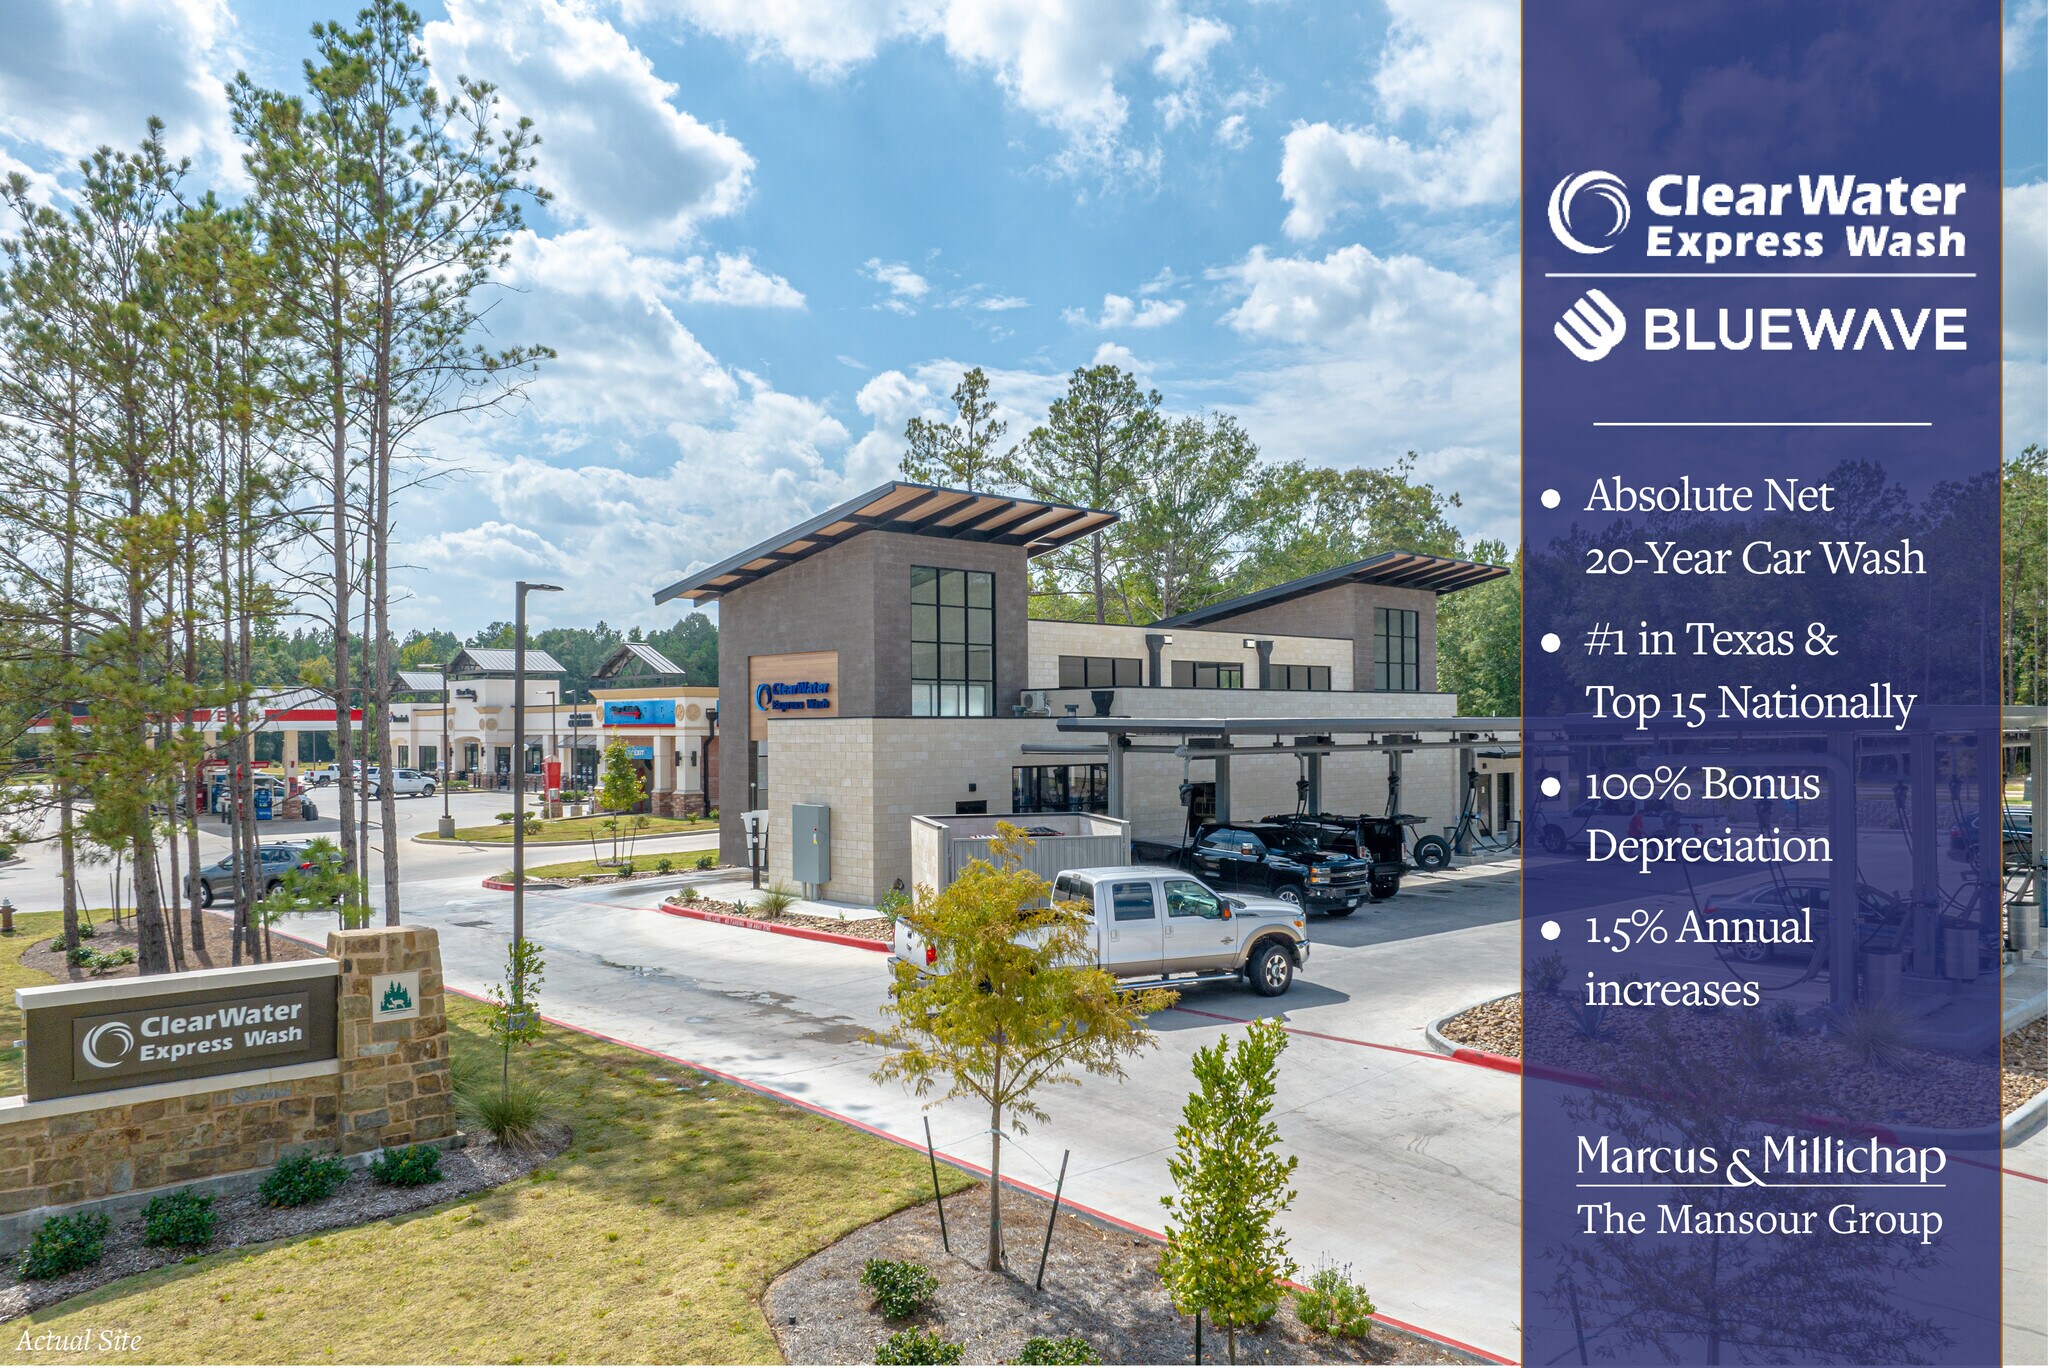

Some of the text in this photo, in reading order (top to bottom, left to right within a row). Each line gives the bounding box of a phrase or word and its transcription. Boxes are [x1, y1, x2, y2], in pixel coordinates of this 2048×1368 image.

[772, 681, 829, 695] ClearWater
[140, 1003, 302, 1039] ClearWater
[140, 1026, 302, 1063] Express Wash
